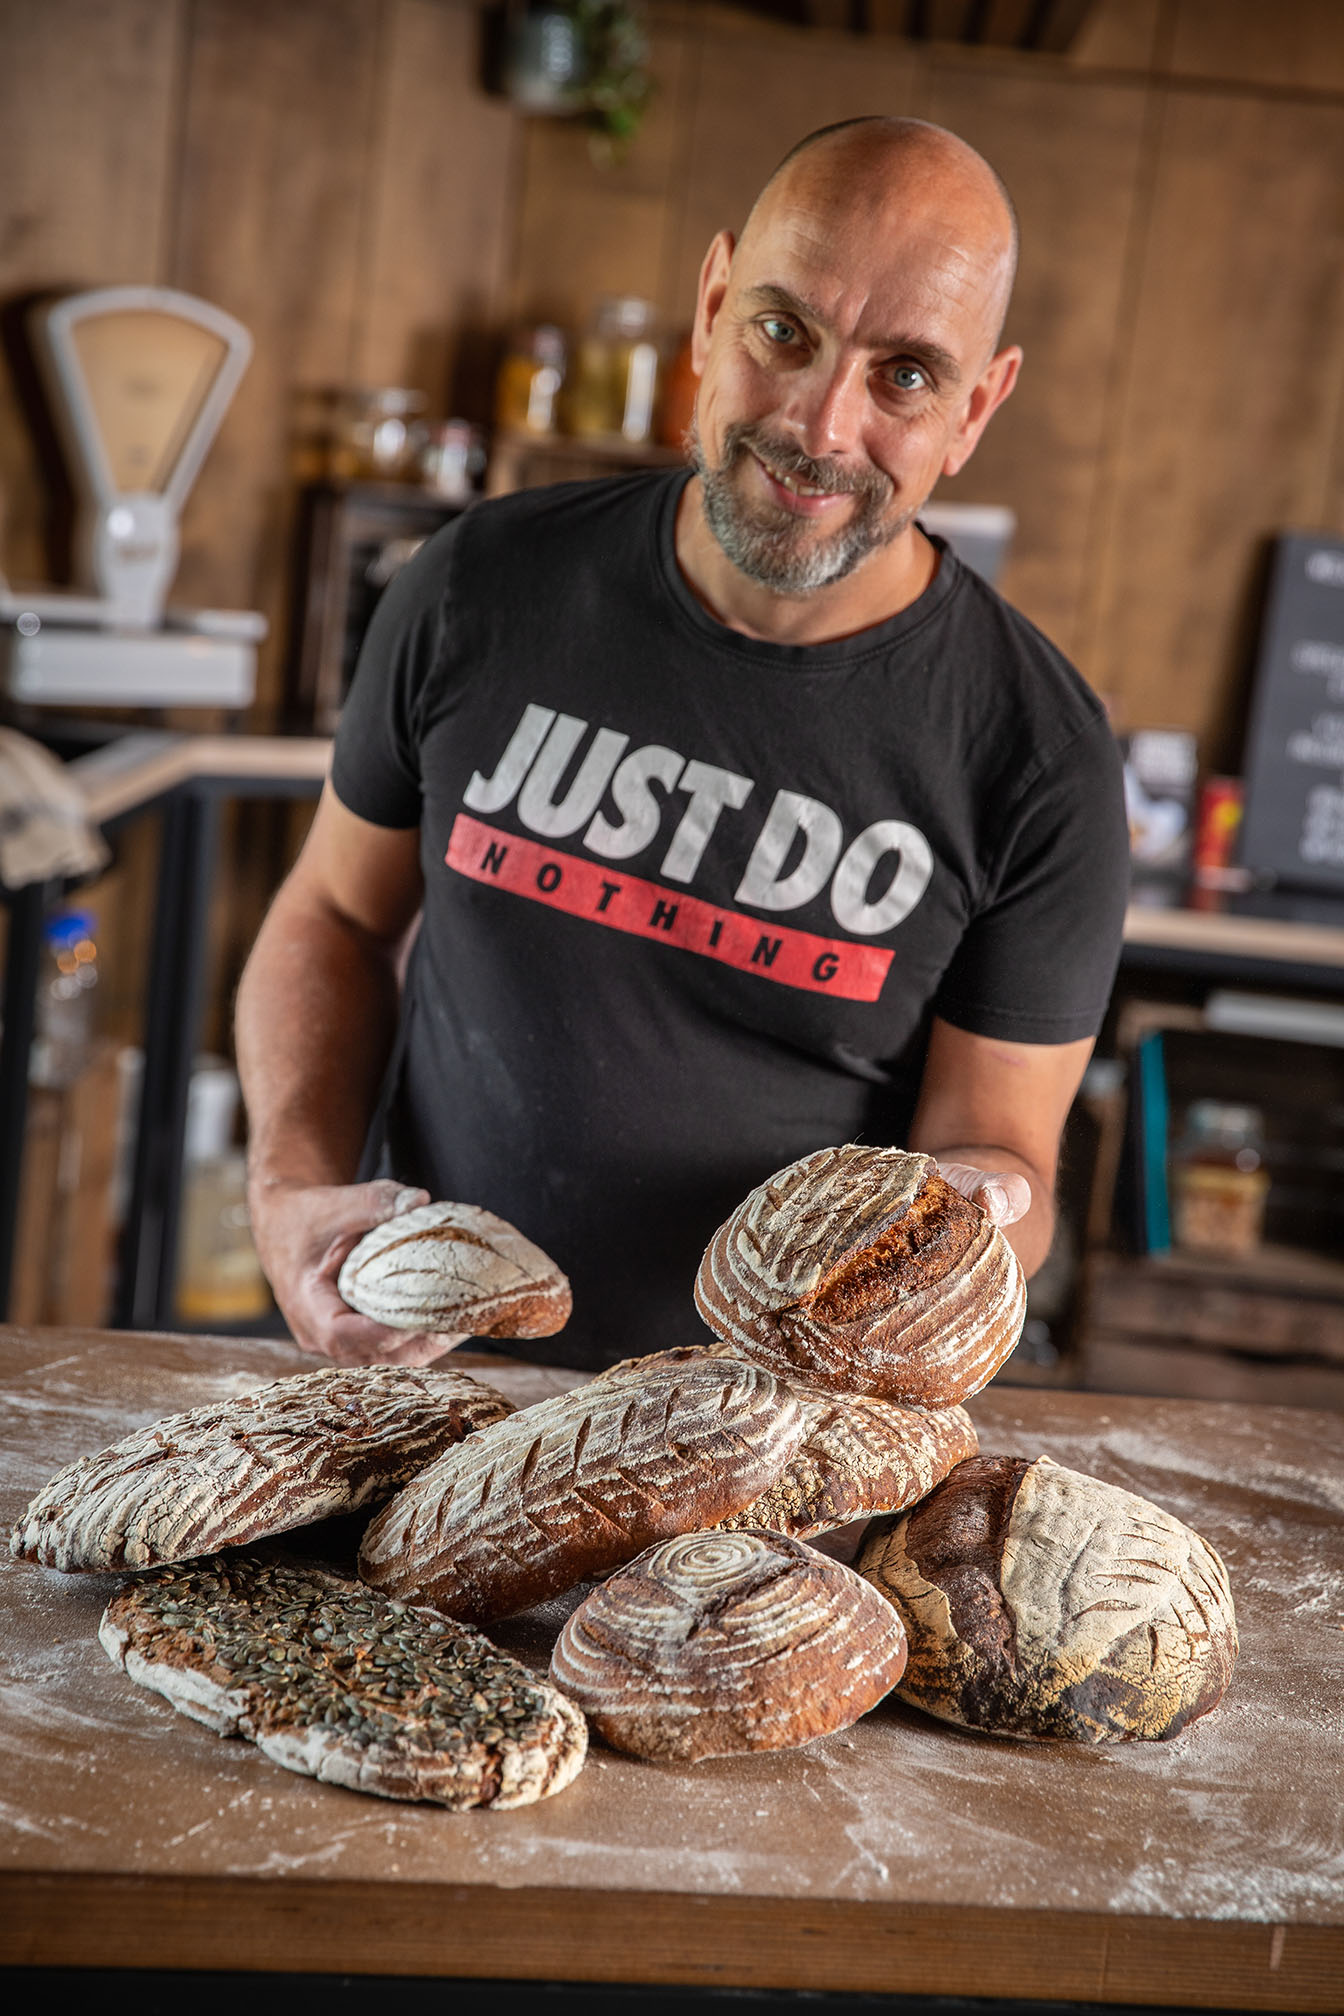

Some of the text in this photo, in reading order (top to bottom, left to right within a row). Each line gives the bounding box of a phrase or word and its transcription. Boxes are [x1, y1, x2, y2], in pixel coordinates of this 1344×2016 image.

[463, 703, 934, 936] JUST DO
[480, 841, 840, 983] NOTHING
